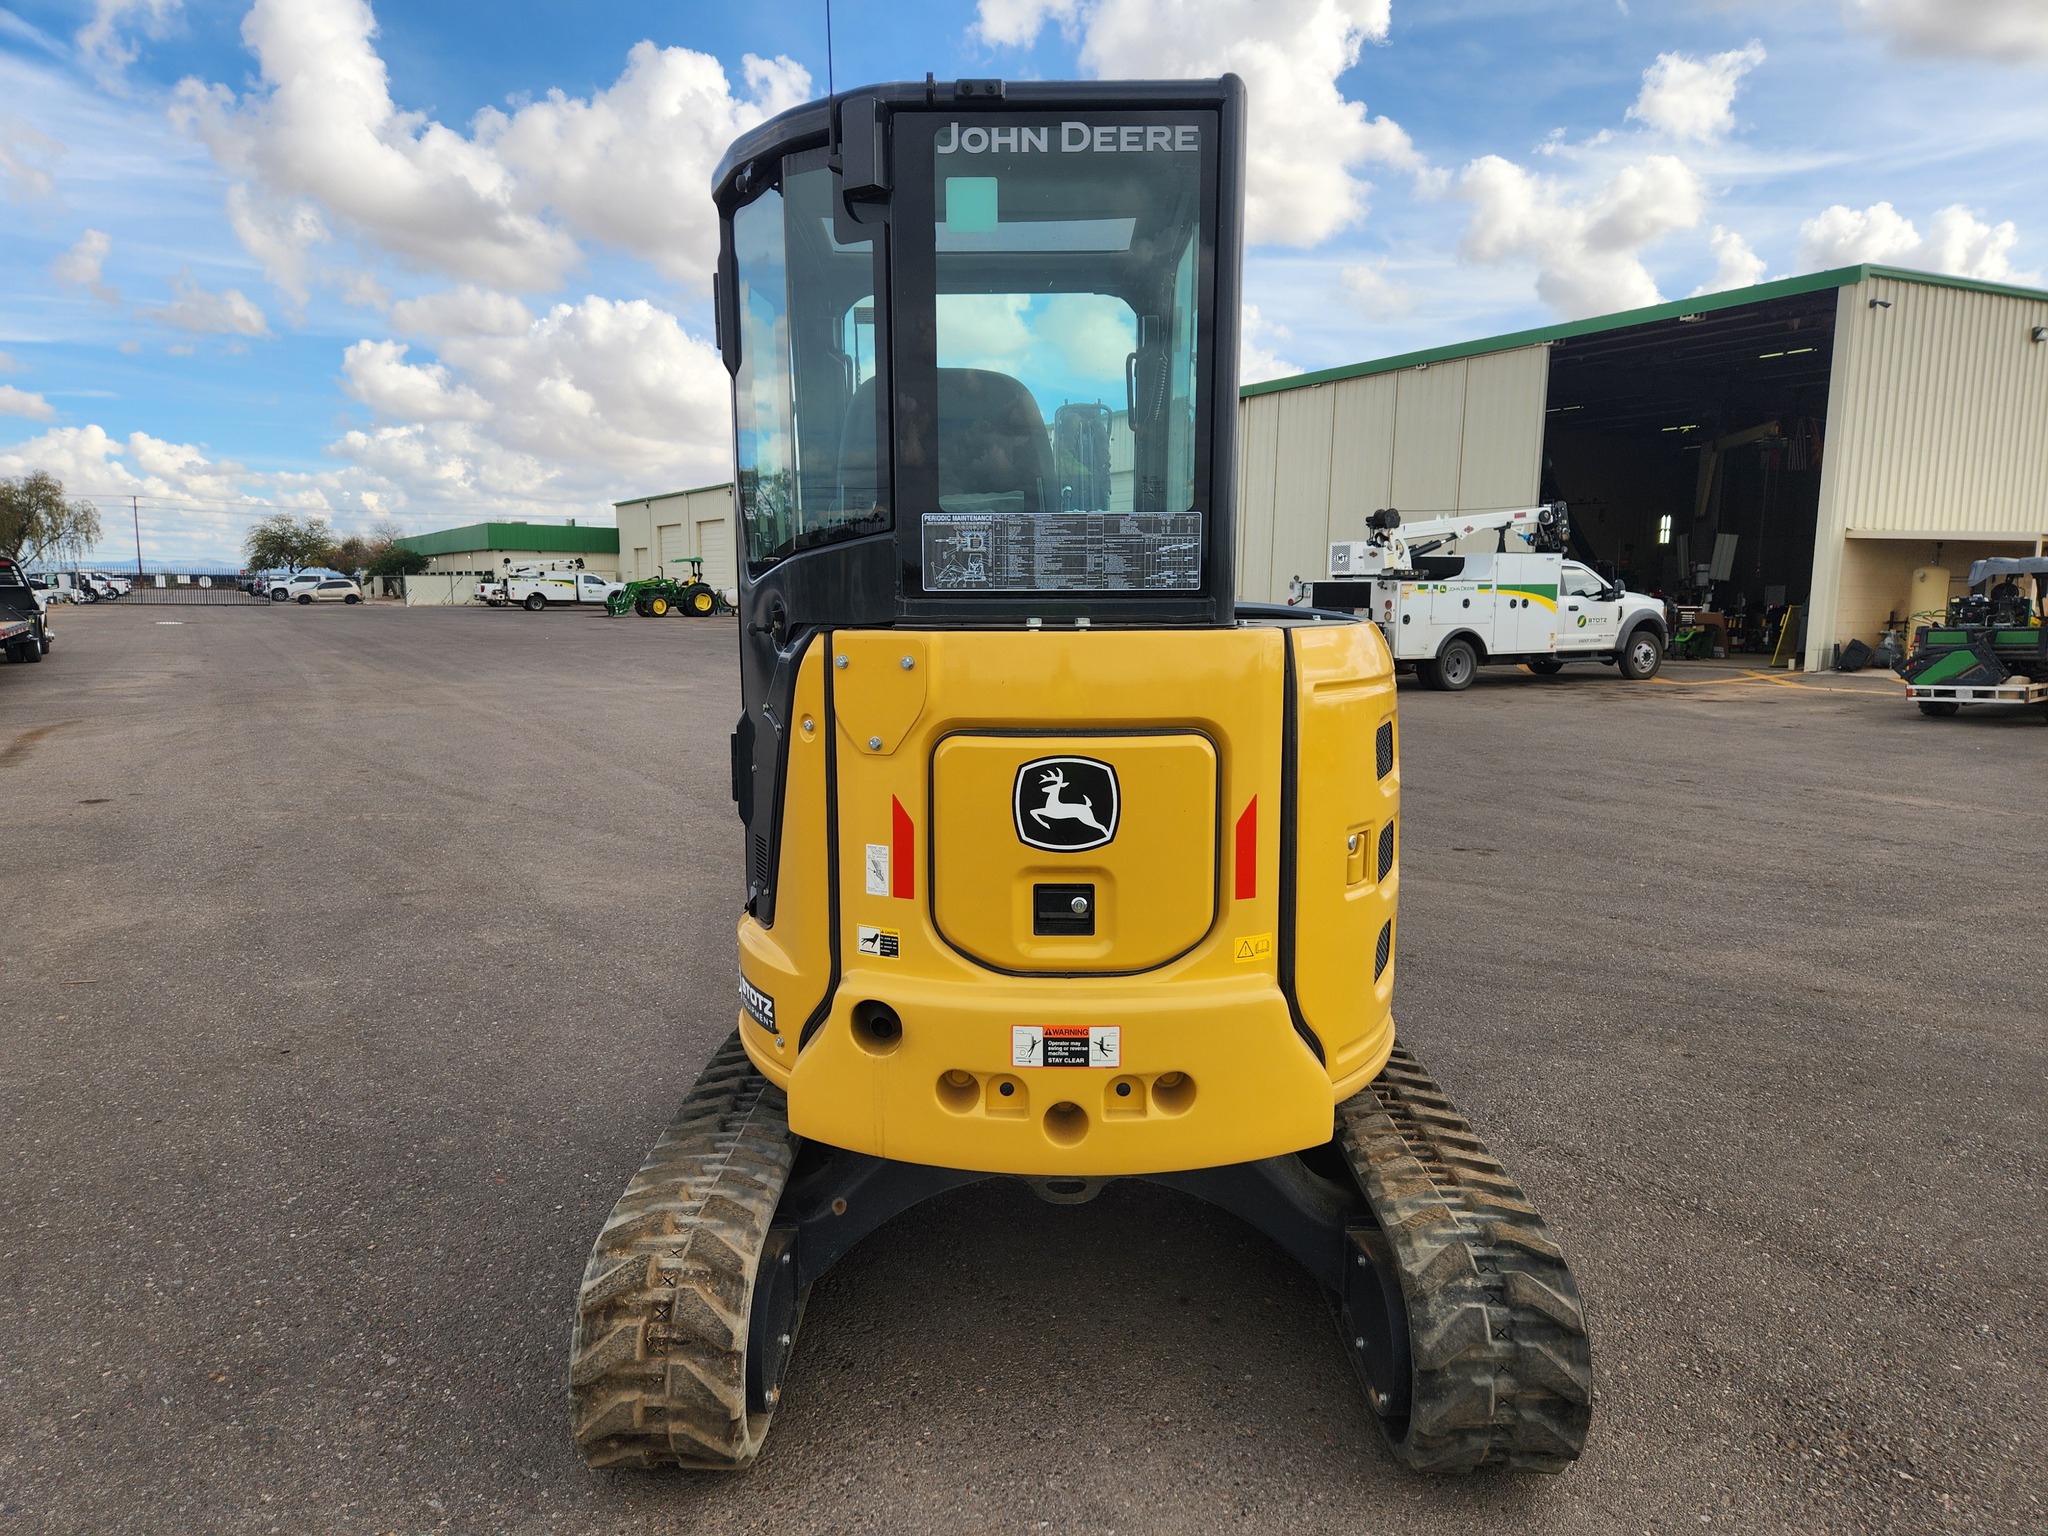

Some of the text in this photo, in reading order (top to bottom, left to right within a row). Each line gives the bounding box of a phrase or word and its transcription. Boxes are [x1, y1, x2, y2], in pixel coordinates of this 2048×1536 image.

[937, 121, 1199, 153] JOHN DEERE
[742, 977, 773, 1018] STOTZ
[1052, 1028, 1088, 1036] WARNING
